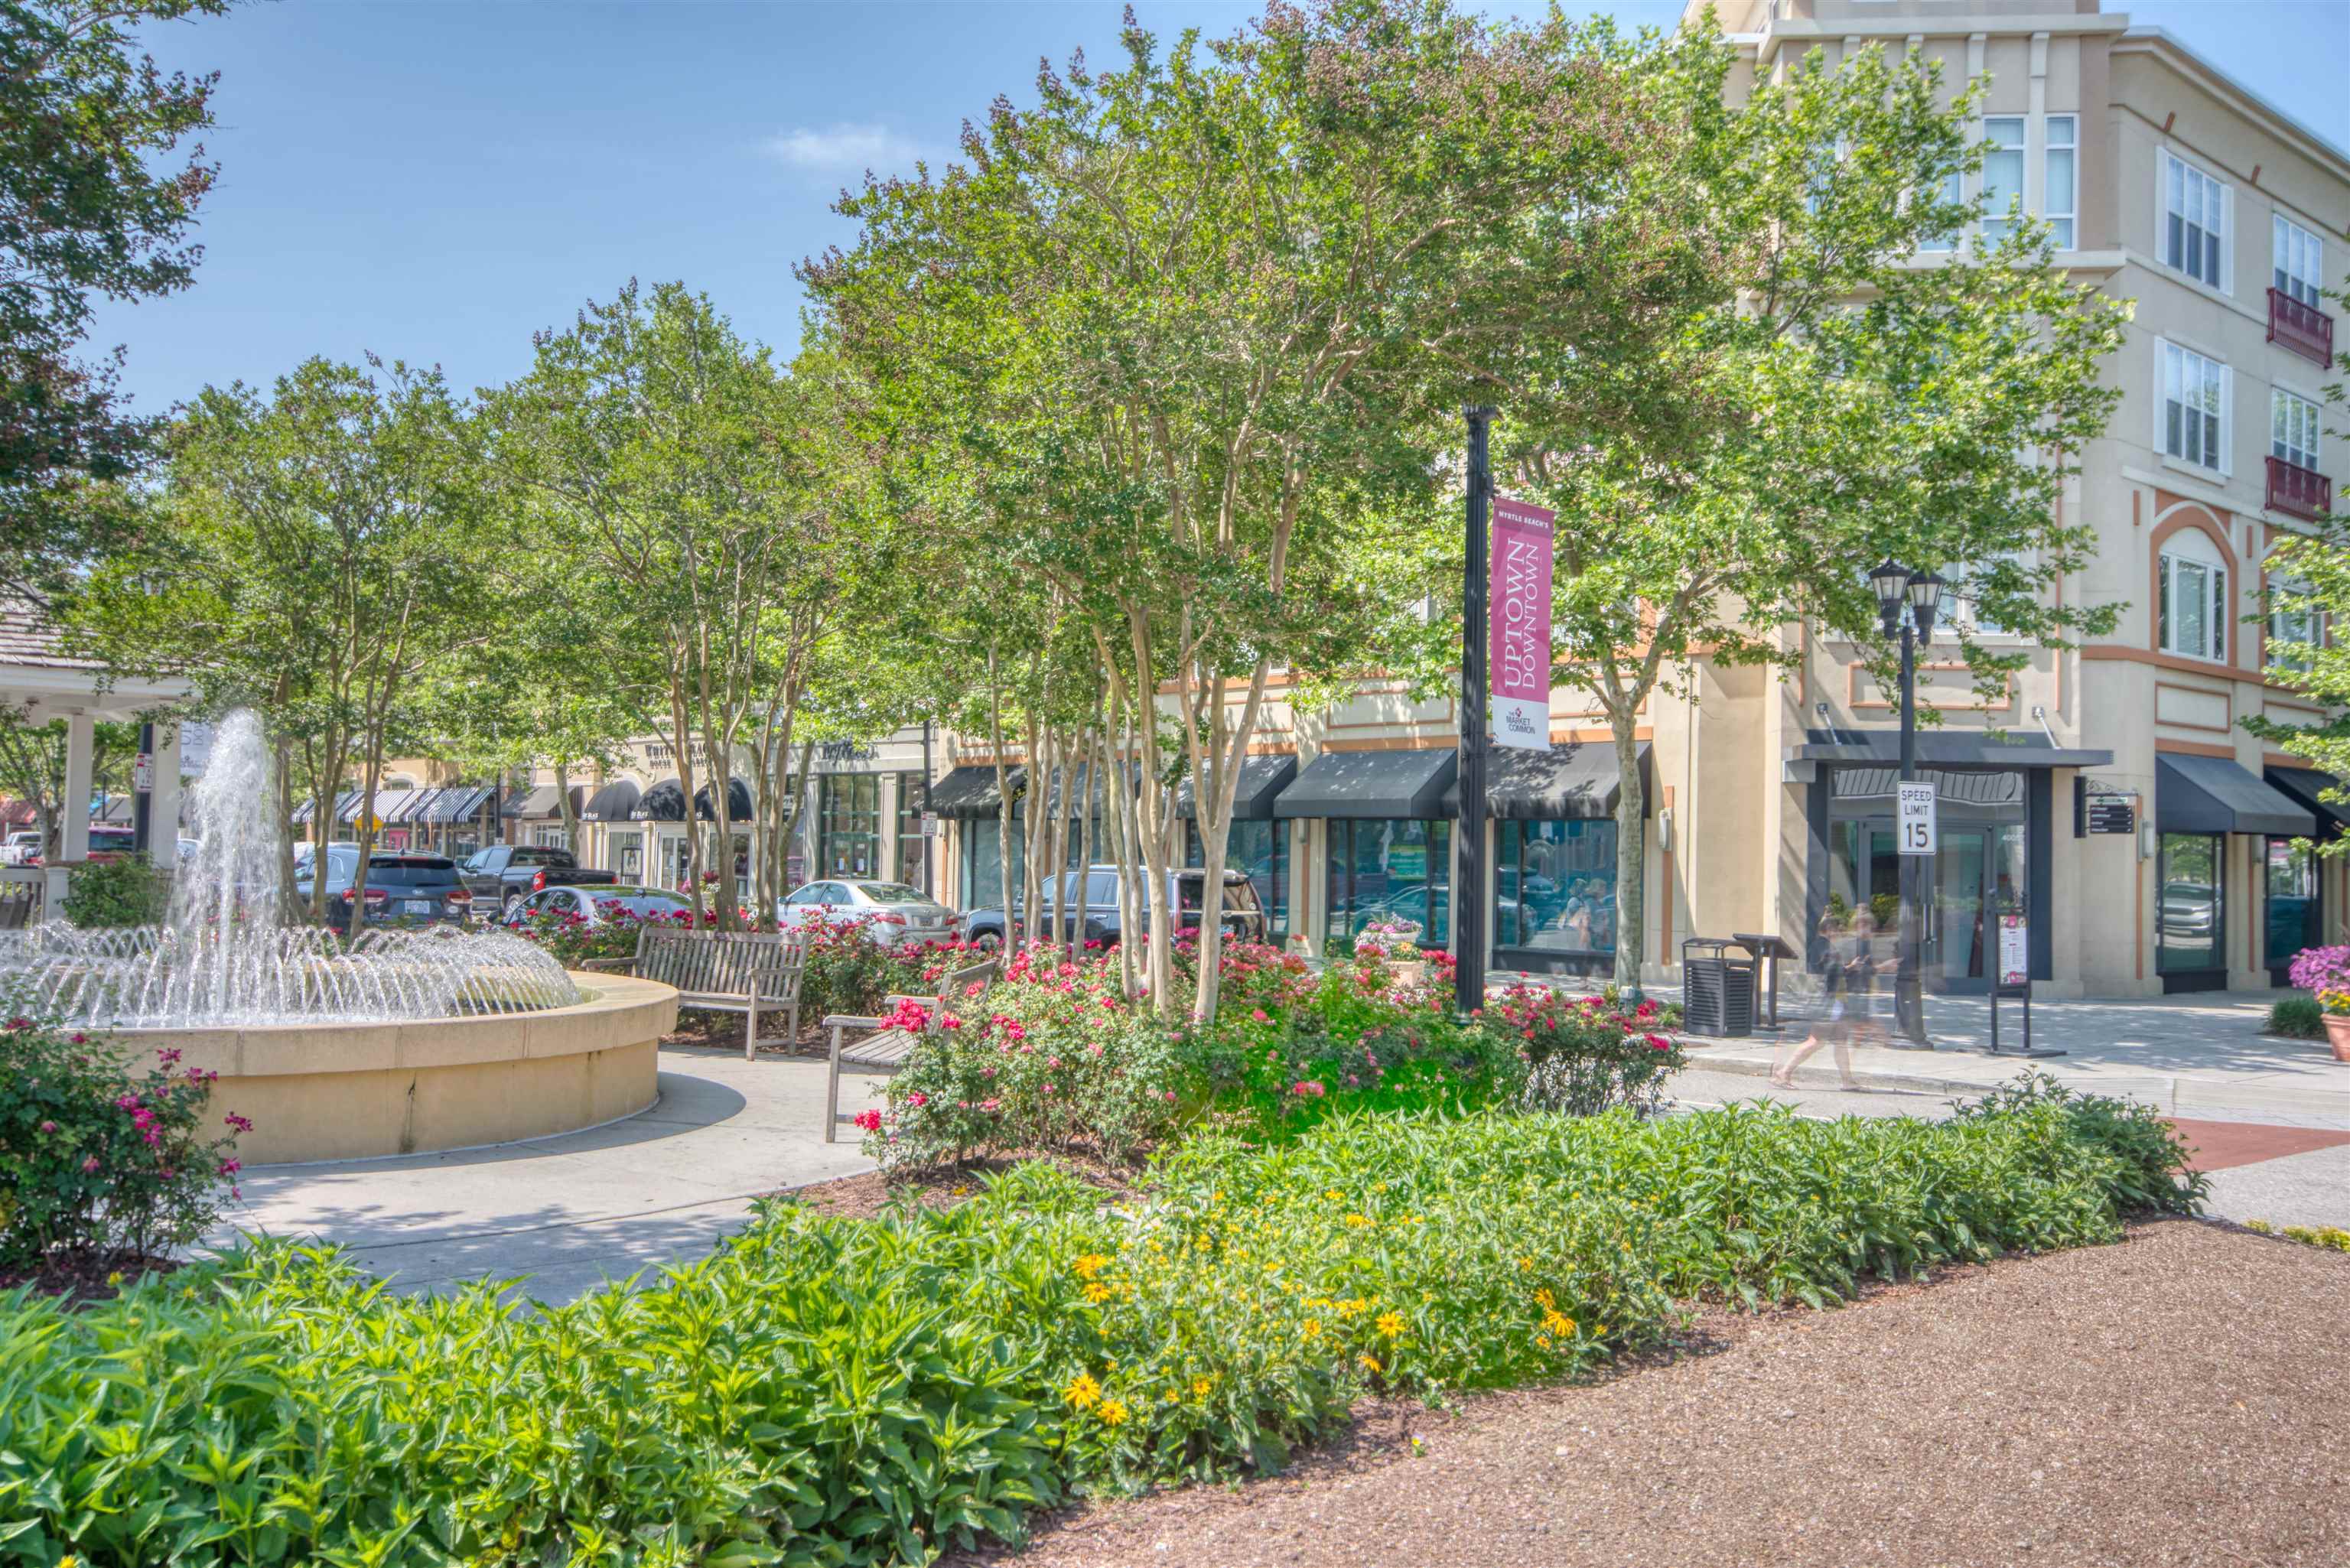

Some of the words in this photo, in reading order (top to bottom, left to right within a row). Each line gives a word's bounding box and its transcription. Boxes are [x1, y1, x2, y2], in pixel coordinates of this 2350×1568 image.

[1499, 510, 1522, 522] MYRTLE
[1524, 516, 1549, 529] BEACH'S
[1505, 538, 1525, 688] UPTOWN
[1523, 544, 1539, 689] DOWNTOWN
[1506, 715, 1531, 726] MARKET
[1509, 724, 1535, 734] COMMON
[1902, 790, 1932, 802] SPEED
[1905, 805, 1928, 816] LIMIT
[1906, 822, 1928, 847] 15
